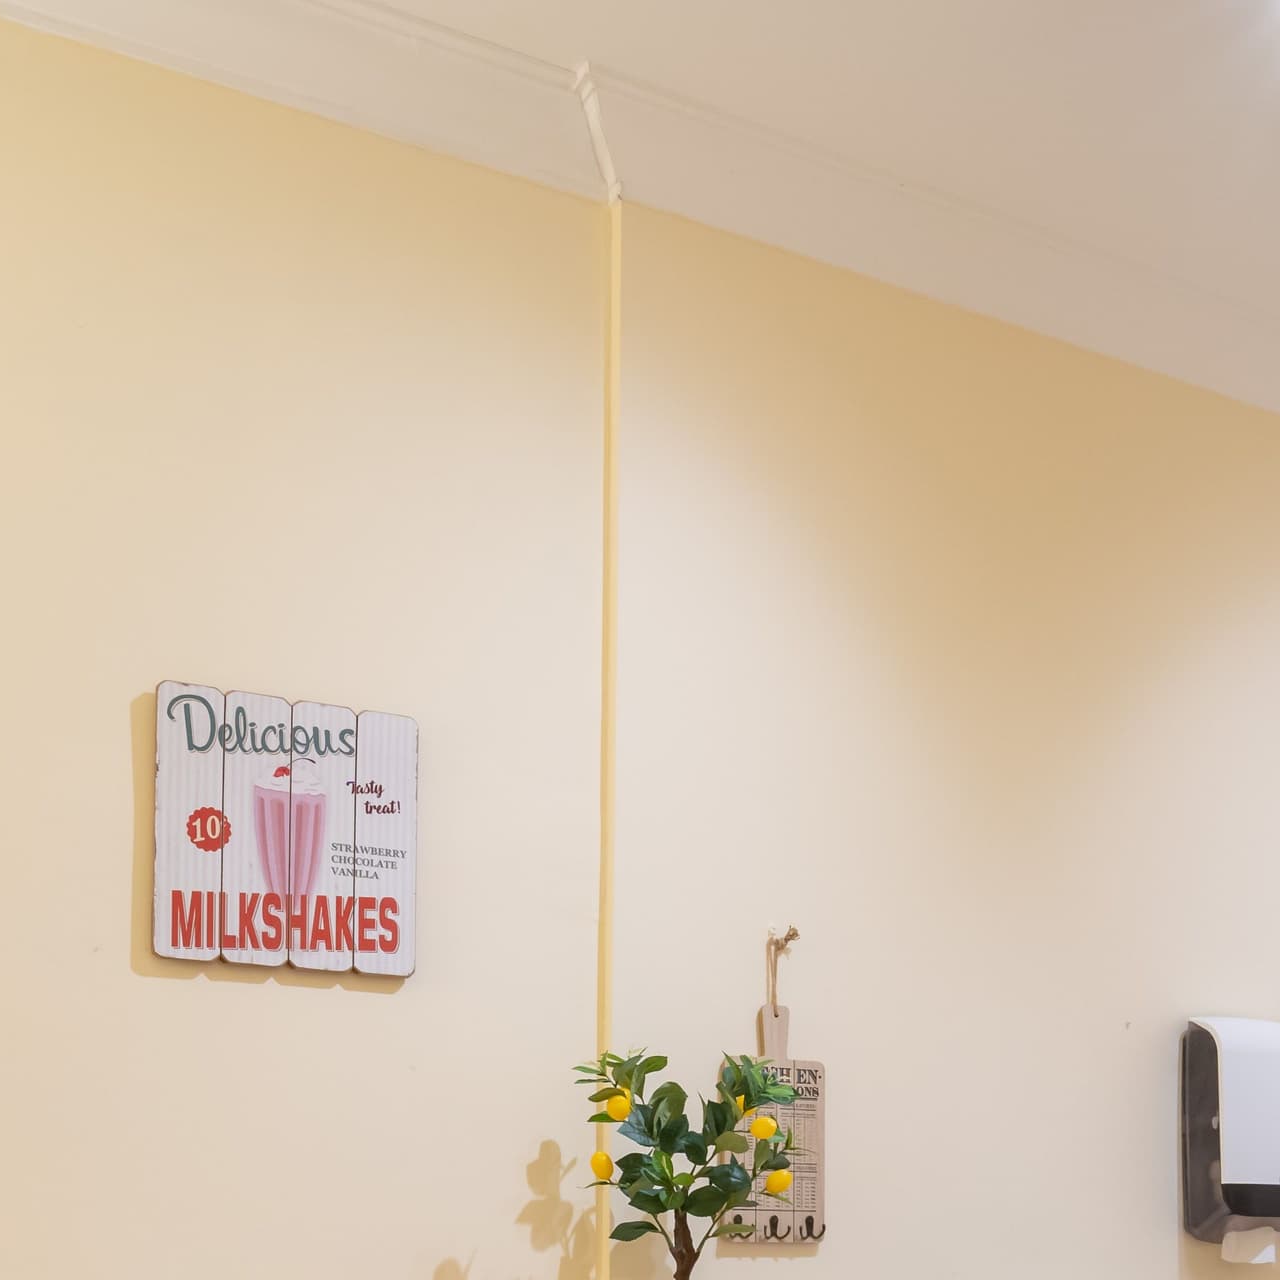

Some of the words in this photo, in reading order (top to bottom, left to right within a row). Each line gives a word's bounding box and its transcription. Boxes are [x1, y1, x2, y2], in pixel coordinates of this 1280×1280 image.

[167, 694, 355, 757] Delicious
[346, 780, 384, 798] Tasty
[363, 800, 401, 815] treat!
[331, 842, 407, 859] STRAWBERRY
[331, 855, 398, 870] CHOCOLATE
[331, 867, 379, 880] VANILLA
[171, 890, 400, 954] MILKSHAKES
